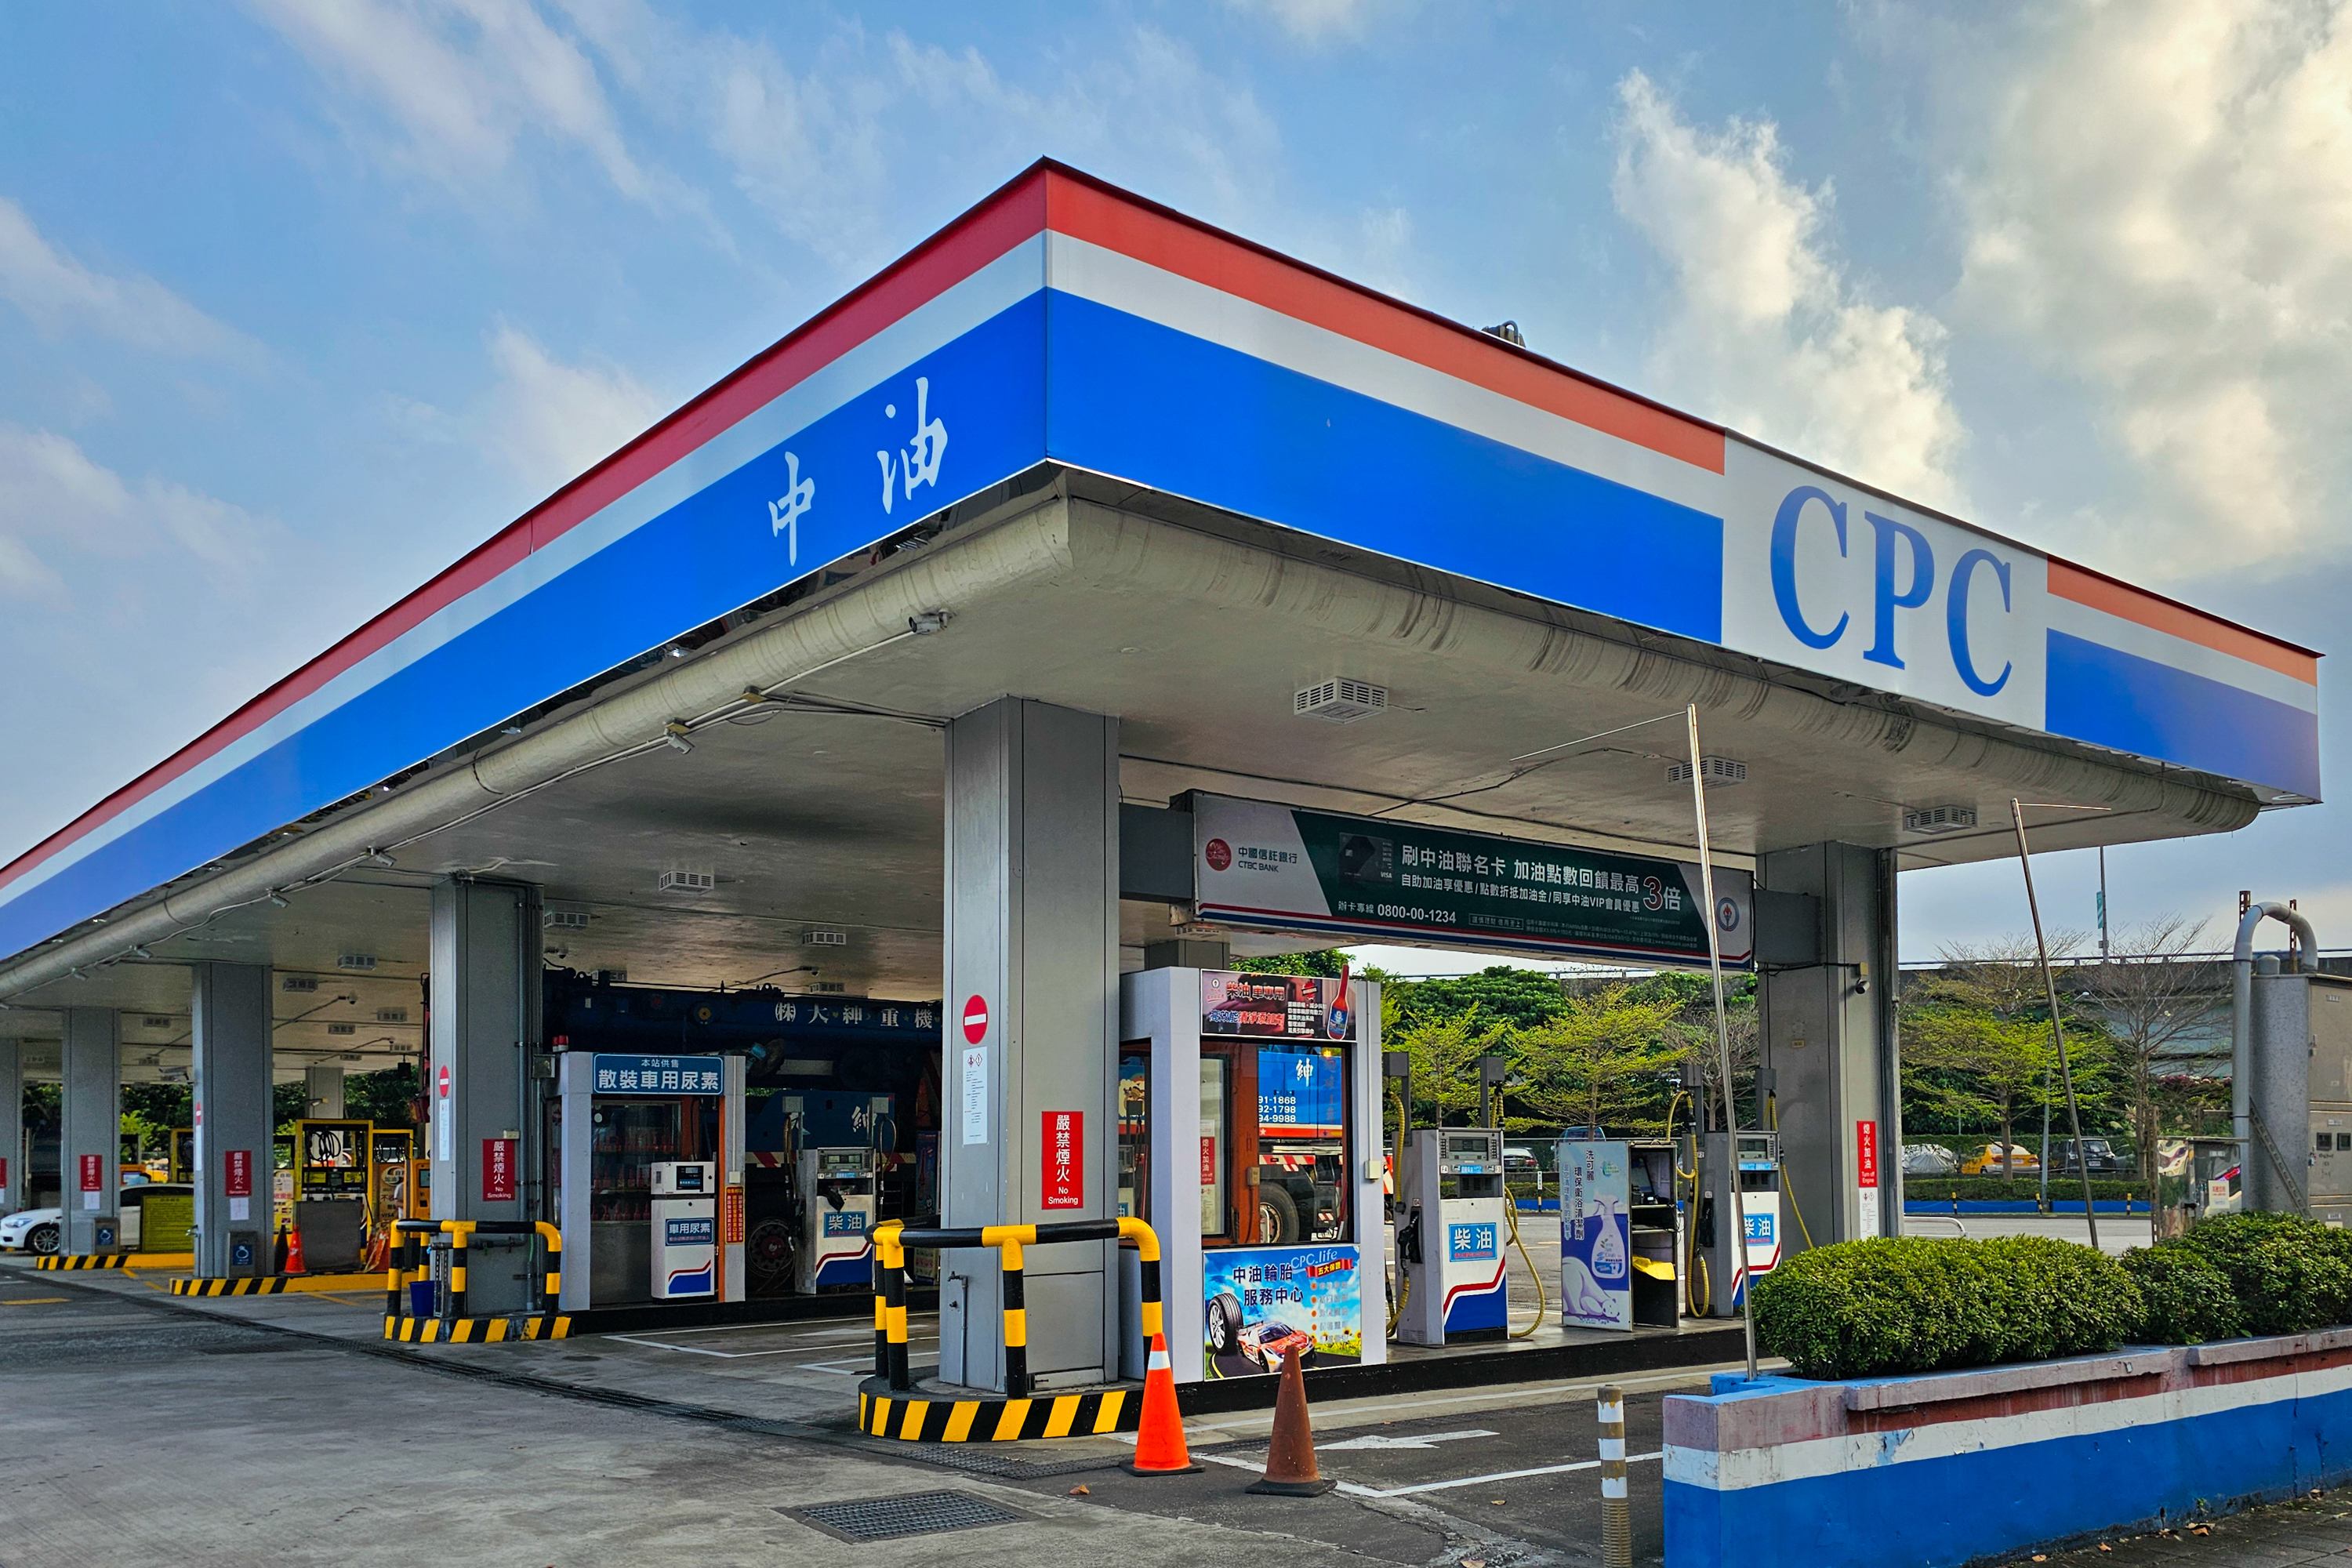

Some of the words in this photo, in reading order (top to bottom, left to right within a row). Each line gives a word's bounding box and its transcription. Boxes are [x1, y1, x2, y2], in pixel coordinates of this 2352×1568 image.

[768, 376, 948, 567] 中油
[1770, 485, 2013, 697] CPC
[1238, 846, 1298, 864] 中國信託銀行
[1402, 844, 1506, 877] 刷中油聯名卡
[1238, 860, 1258, 870] CTBC
[1258, 862, 1279, 873] BANK
[1380, 870, 1392, 879] VISA
[1338, 900, 1374, 914] 辦卡專線
[1377, 903, 1457, 924] 0800-00-1234
[1225, 981, 1285, 1001] 柴油車專用
[641, 1058, 680, 1069] 本站供售
[598, 1069, 719, 1091] 散裝車用尿素
[1055, 1114, 1071, 1182] 嚴禁煙火
[1863, 1123, 1871, 1170] 熄火加油
[493, 1141, 505, 1185] 嚴禁煙火
[1058, 1186, 1069, 1195] No
[1047, 1196, 1079, 1206] Smoking
[668, 1222, 711, 1234] 車用尿素
[828, 1214, 862, 1231] 柴油
[1454, 1226, 1493, 1250] 柴油
[1232, 1263, 1294, 1283] 中油輪胎
[1317, 1261, 1341, 1276] 五大保證
[1243, 1287, 1304, 1306] 服務中心
